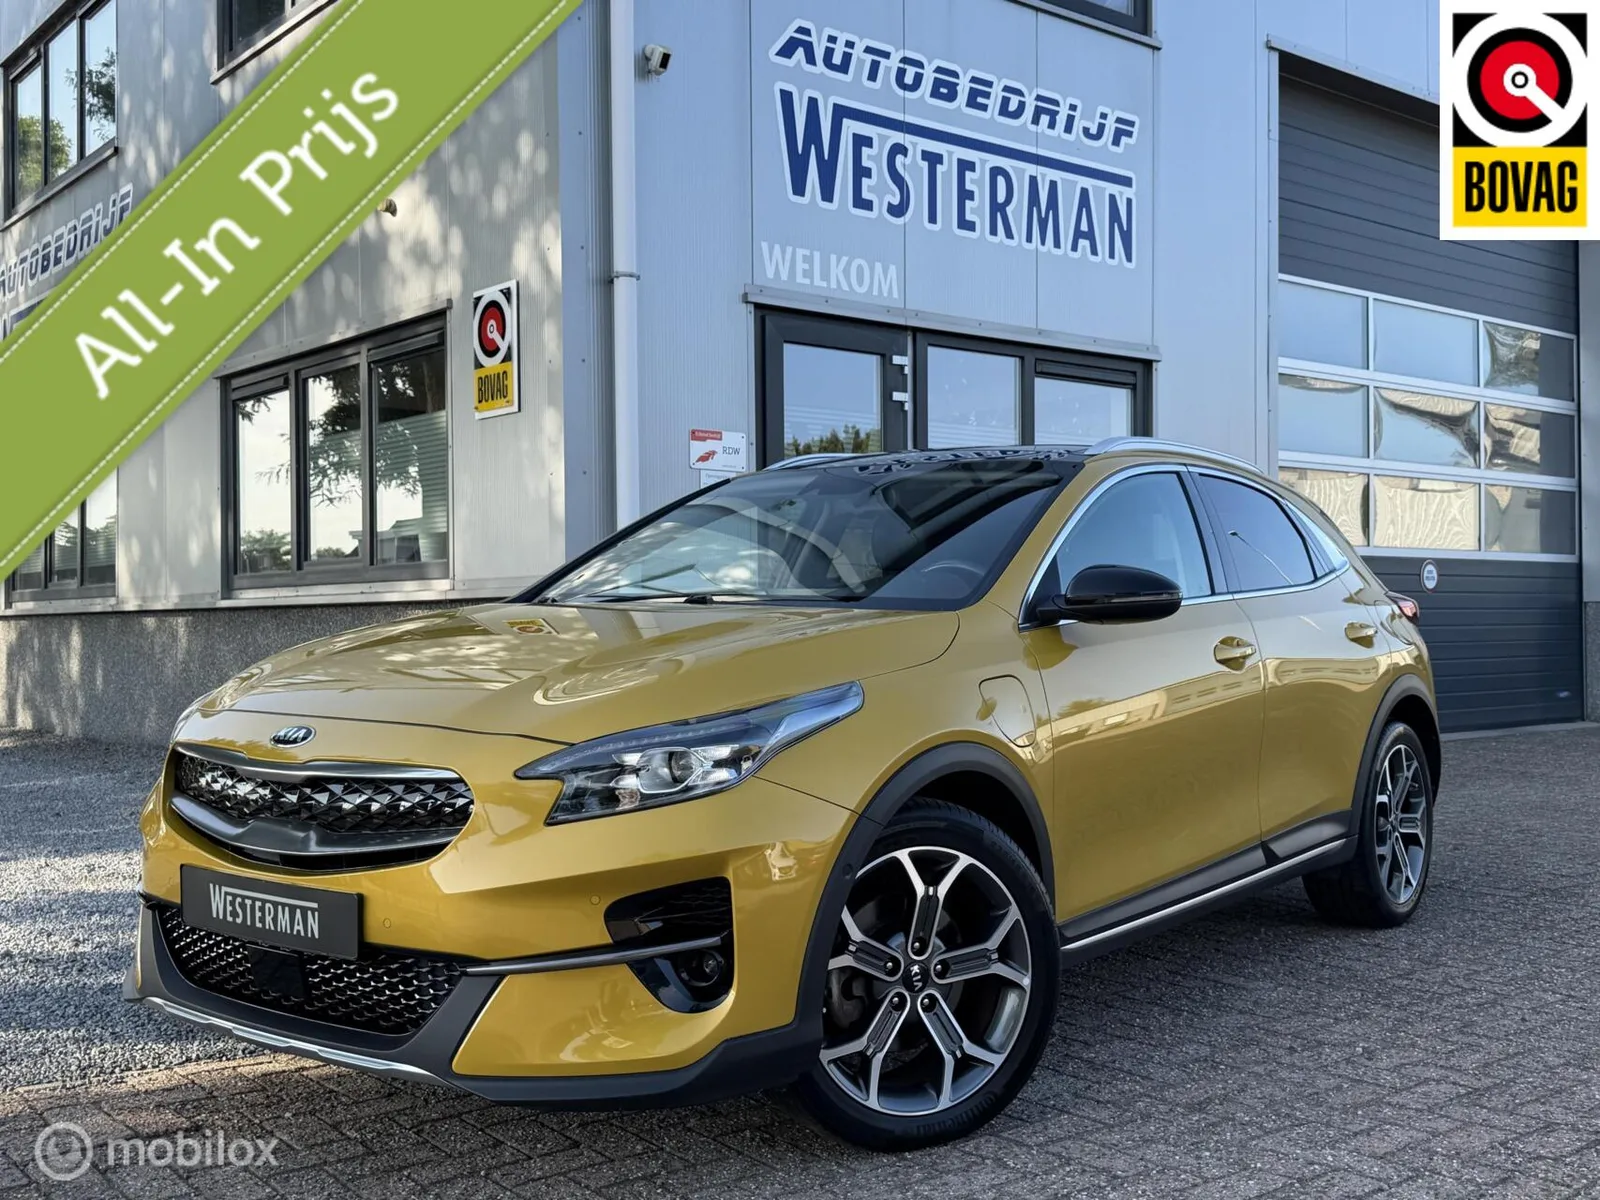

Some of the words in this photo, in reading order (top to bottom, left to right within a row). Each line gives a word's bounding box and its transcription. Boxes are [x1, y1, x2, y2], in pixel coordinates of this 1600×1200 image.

[775, 24, 1136, 148] AUTOBEDRIJF
[779, 86, 1134, 265] WESTERMAN
[760, 241, 899, 299] WELKOM
[477, 370, 509, 404] BOVAG
[722, 446, 741, 456] RDW
[274, 727, 307, 742] KIA
[209, 883, 319, 939] WESTERMAN
